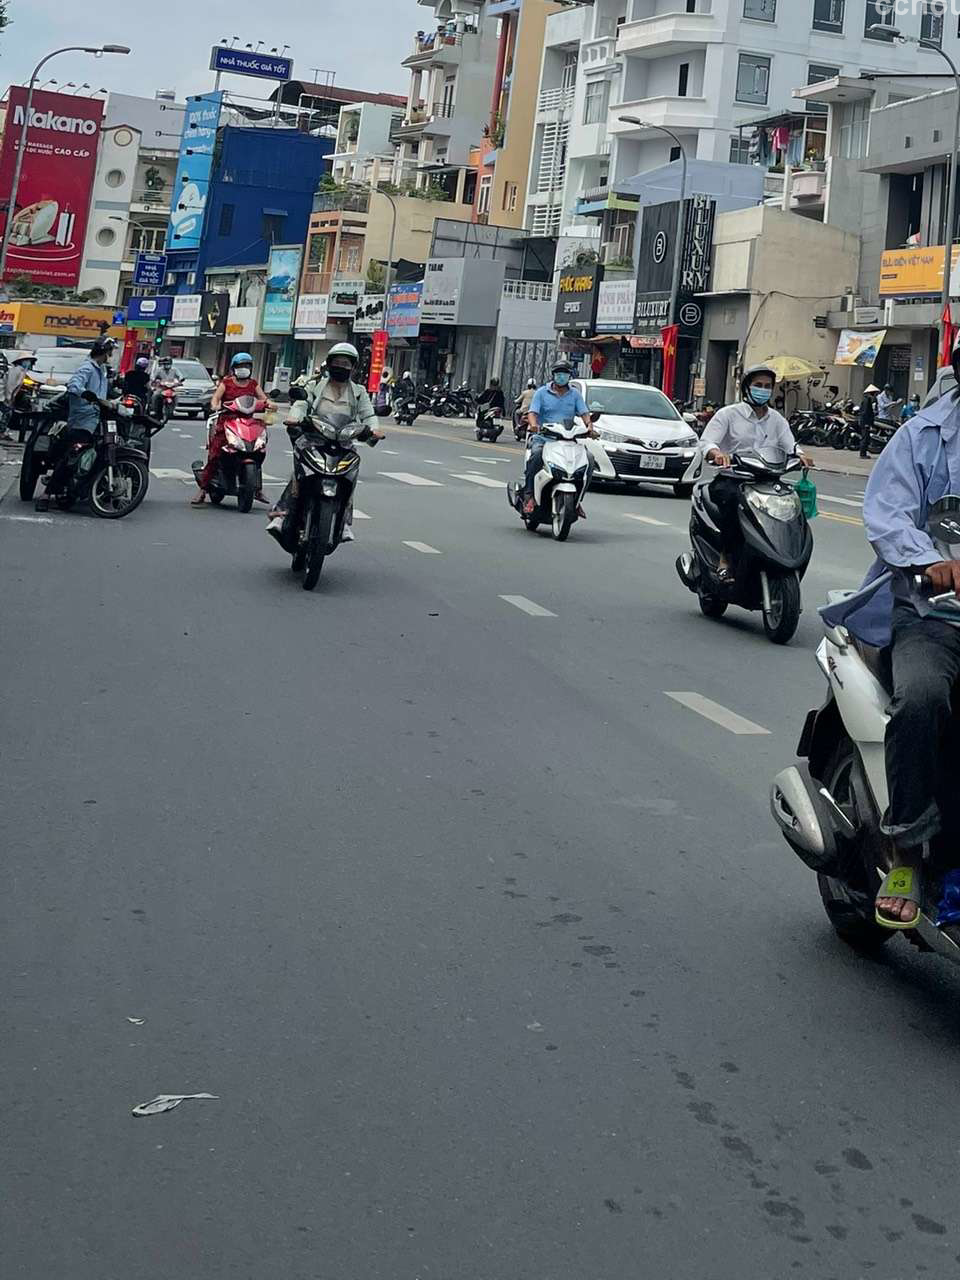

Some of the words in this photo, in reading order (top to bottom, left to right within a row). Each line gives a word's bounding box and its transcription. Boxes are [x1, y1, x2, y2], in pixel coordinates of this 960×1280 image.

[13, 105, 97, 136] Makano
[54, 146, 72, 156] CAO
[73, 148, 90, 158] CẤP
[44, 313, 106, 328] mobifon
